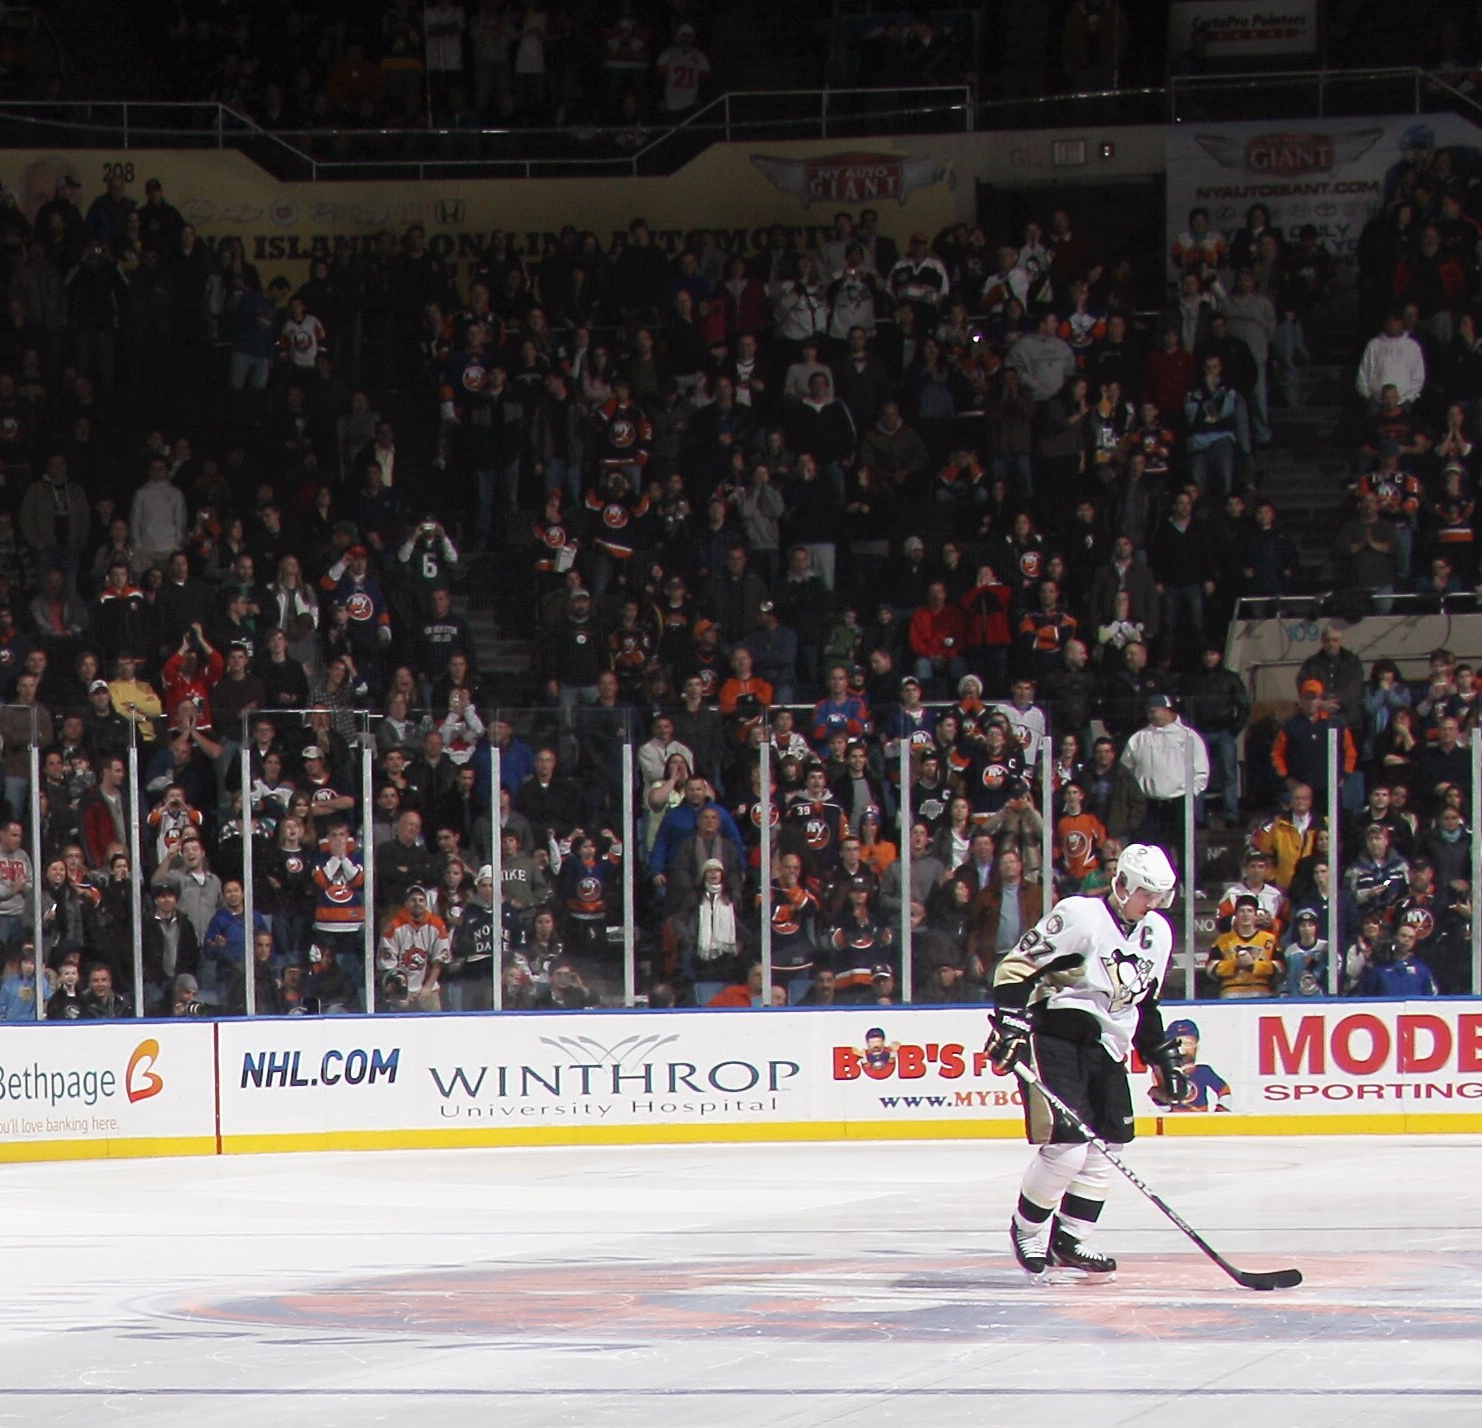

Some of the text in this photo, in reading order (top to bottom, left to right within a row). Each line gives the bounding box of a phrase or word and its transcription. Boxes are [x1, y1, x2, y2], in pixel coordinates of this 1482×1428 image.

[1249, 149, 1328, 168] GIANT
[810, 177, 898, 200] GIANT
[422, 553, 438, 578] 6
[1019, 929, 1056, 961] 87
[1140, 925, 1153, 950] C
[241, 1048, 401, 1090] NHL.COM
[428, 1059, 800, 1099] WINTHROP
[439, 1098, 779, 1119] University Hospital
[21, 1117, 43, 1134] love
[46, 1116, 88, 1136] banking
[91, 1116, 120, 1133] here.
